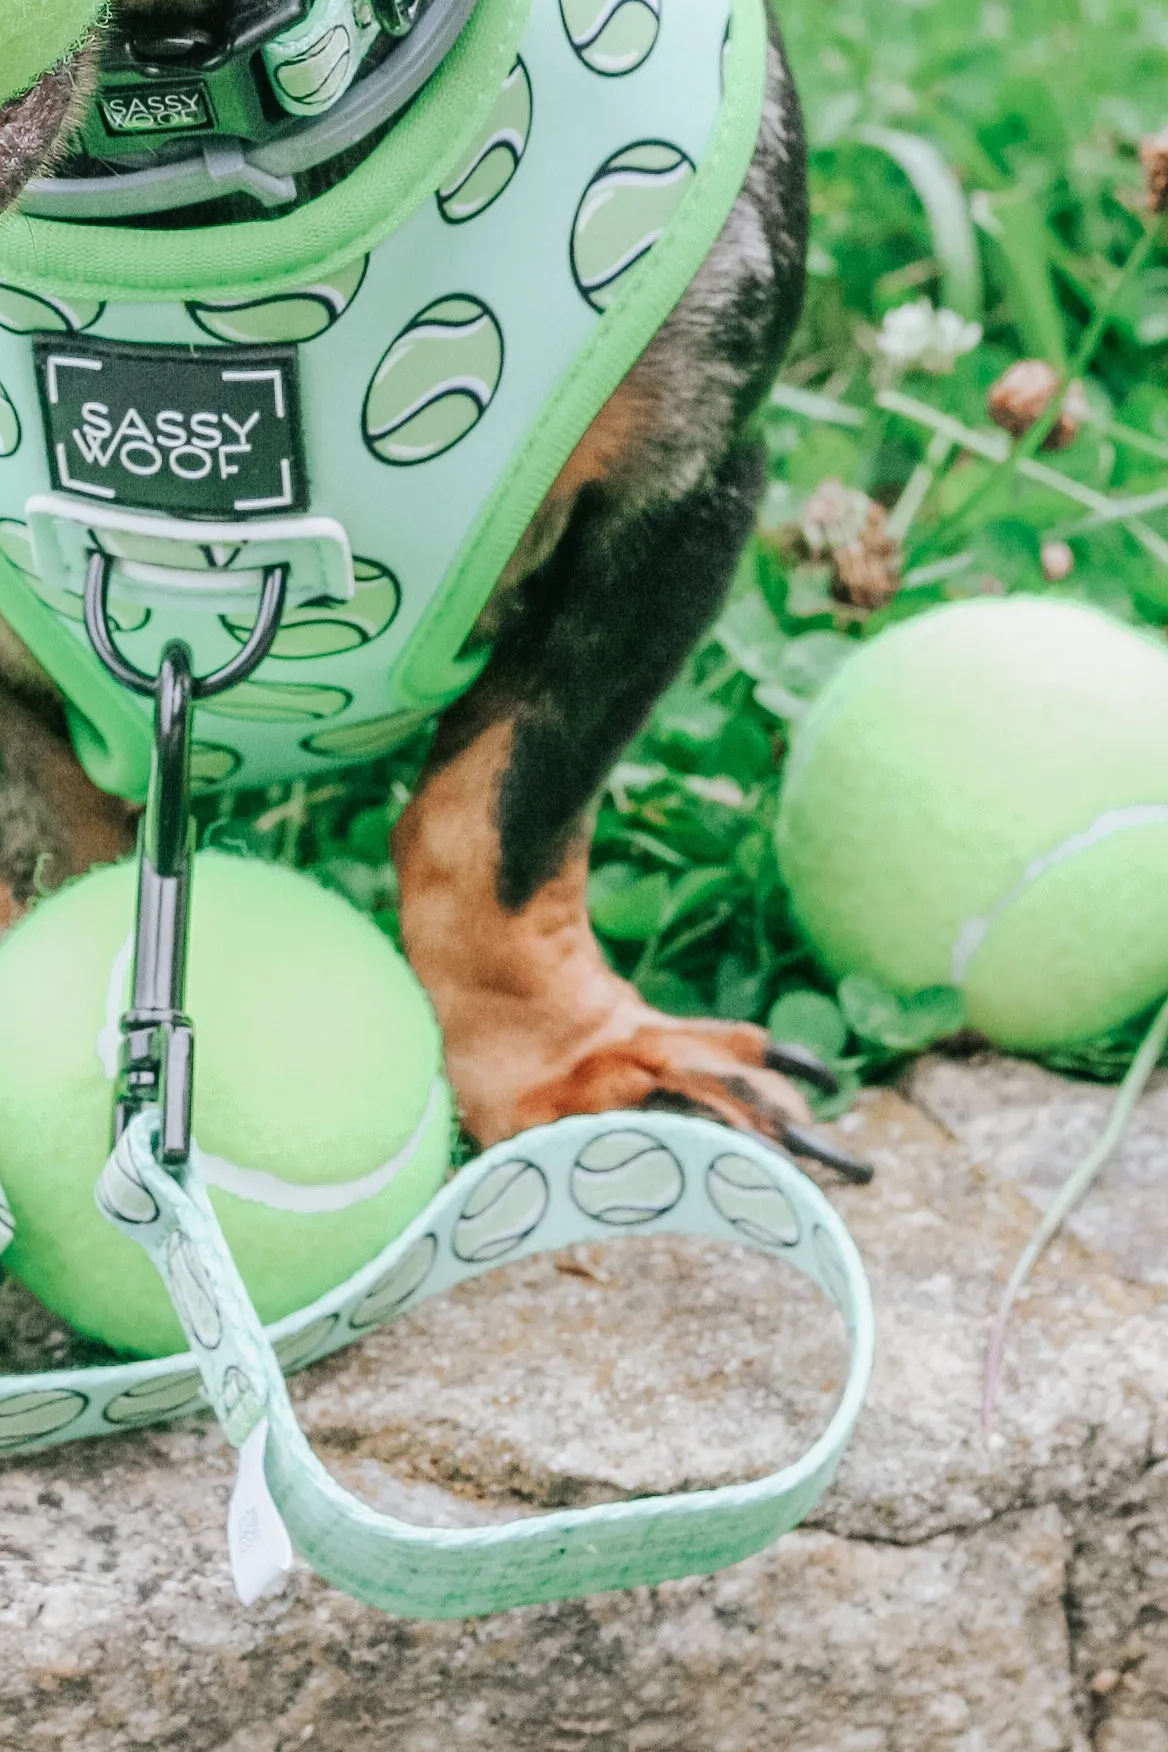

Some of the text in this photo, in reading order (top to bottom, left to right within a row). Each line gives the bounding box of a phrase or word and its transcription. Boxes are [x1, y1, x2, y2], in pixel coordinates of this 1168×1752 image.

[103, 104, 198, 128] WOOF
[109, 94, 199, 115] SASSY
[82, 402, 260, 448] SASSY
[72, 428, 252, 480] WOOF
